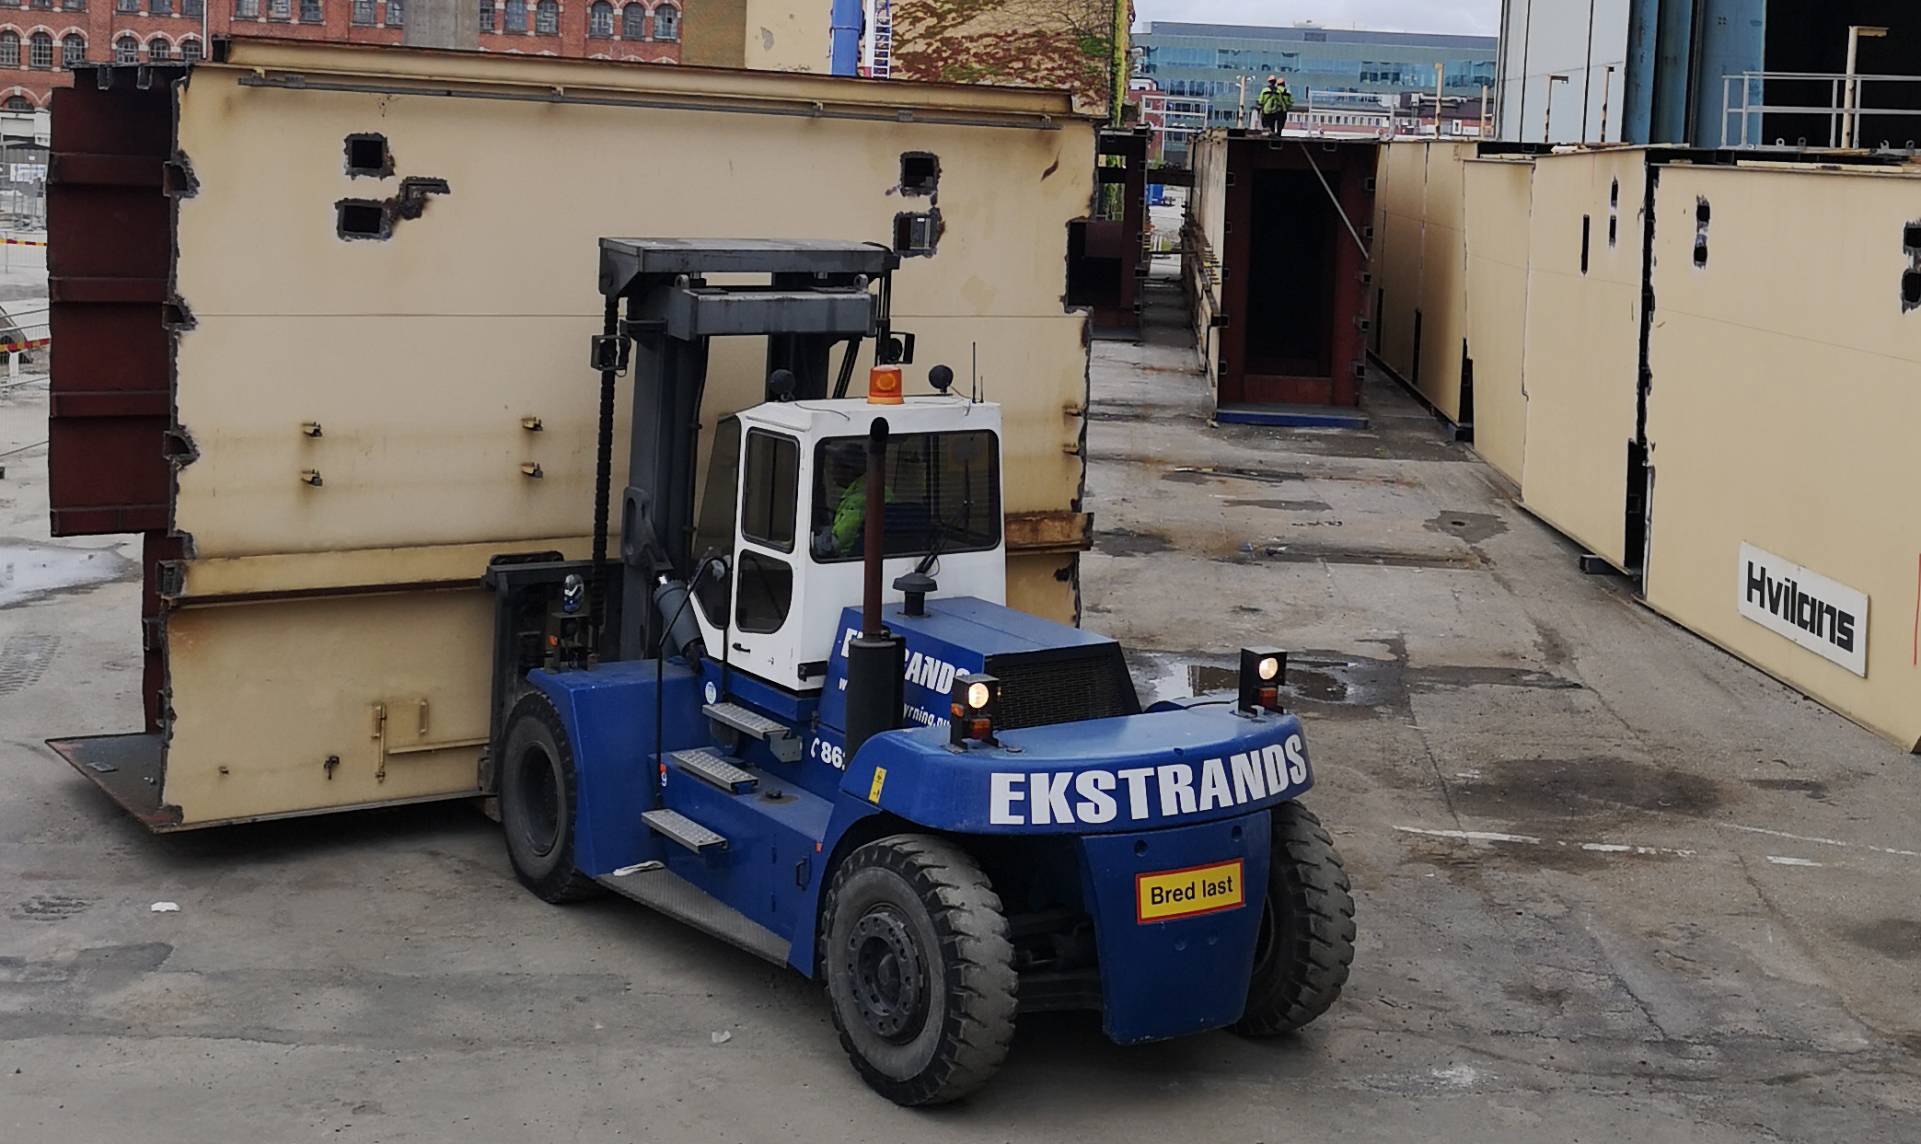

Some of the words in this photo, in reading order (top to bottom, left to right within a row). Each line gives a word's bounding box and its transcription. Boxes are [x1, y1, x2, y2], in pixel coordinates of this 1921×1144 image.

[1747, 560, 1855, 653] Hvilans
[989, 734, 1307, 825] EKSTRANDS
[1151, 881, 1196, 906] Bred
[1202, 875, 1233, 898] last
